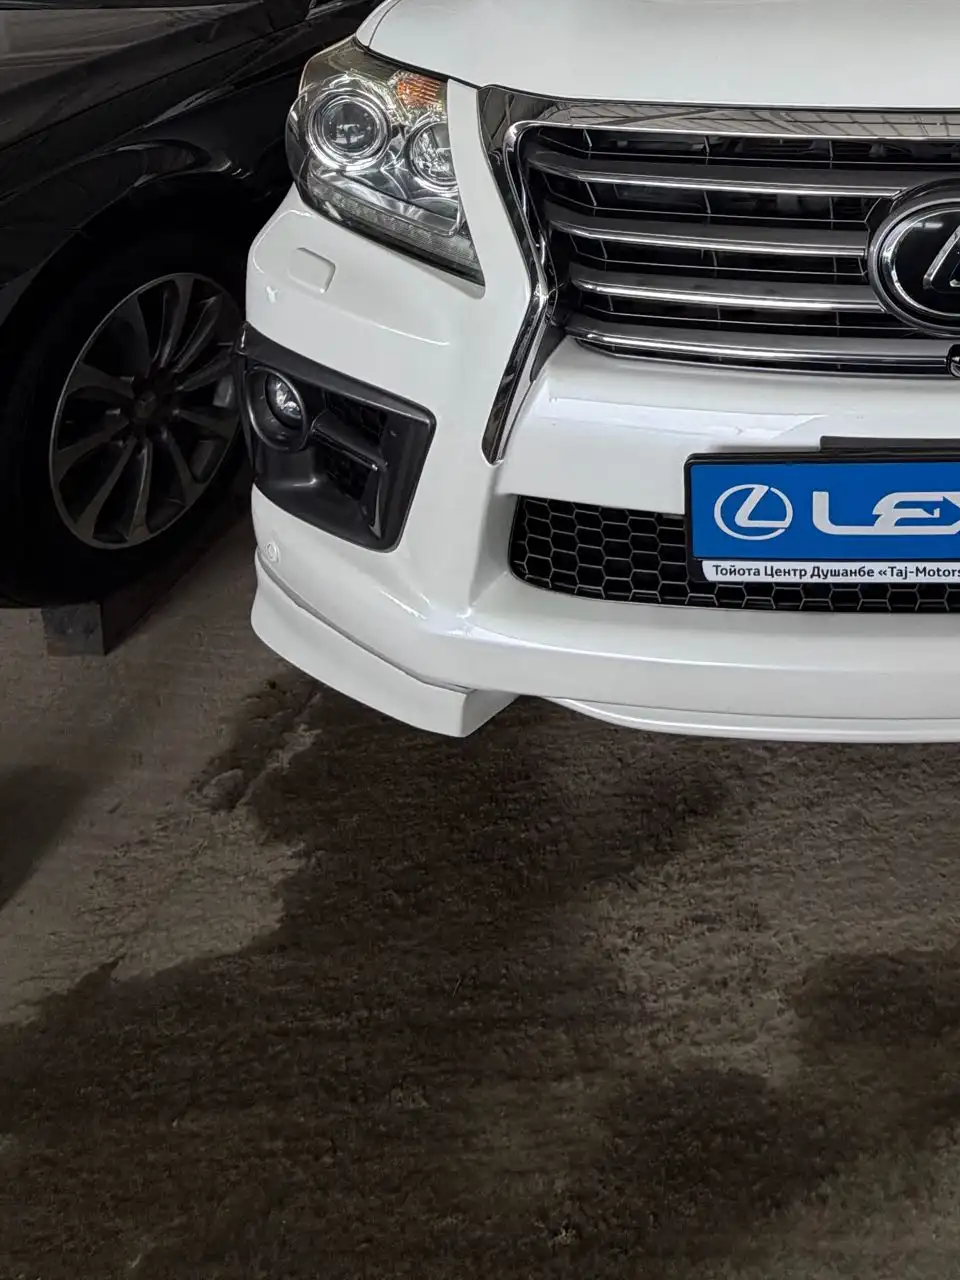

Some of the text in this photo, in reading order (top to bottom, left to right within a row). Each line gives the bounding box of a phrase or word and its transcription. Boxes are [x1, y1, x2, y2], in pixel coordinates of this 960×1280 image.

[712, 564, 761, 578] Тойота
[764, 565, 807, 581] Центр
[811, 565, 875, 581] Душанбе
